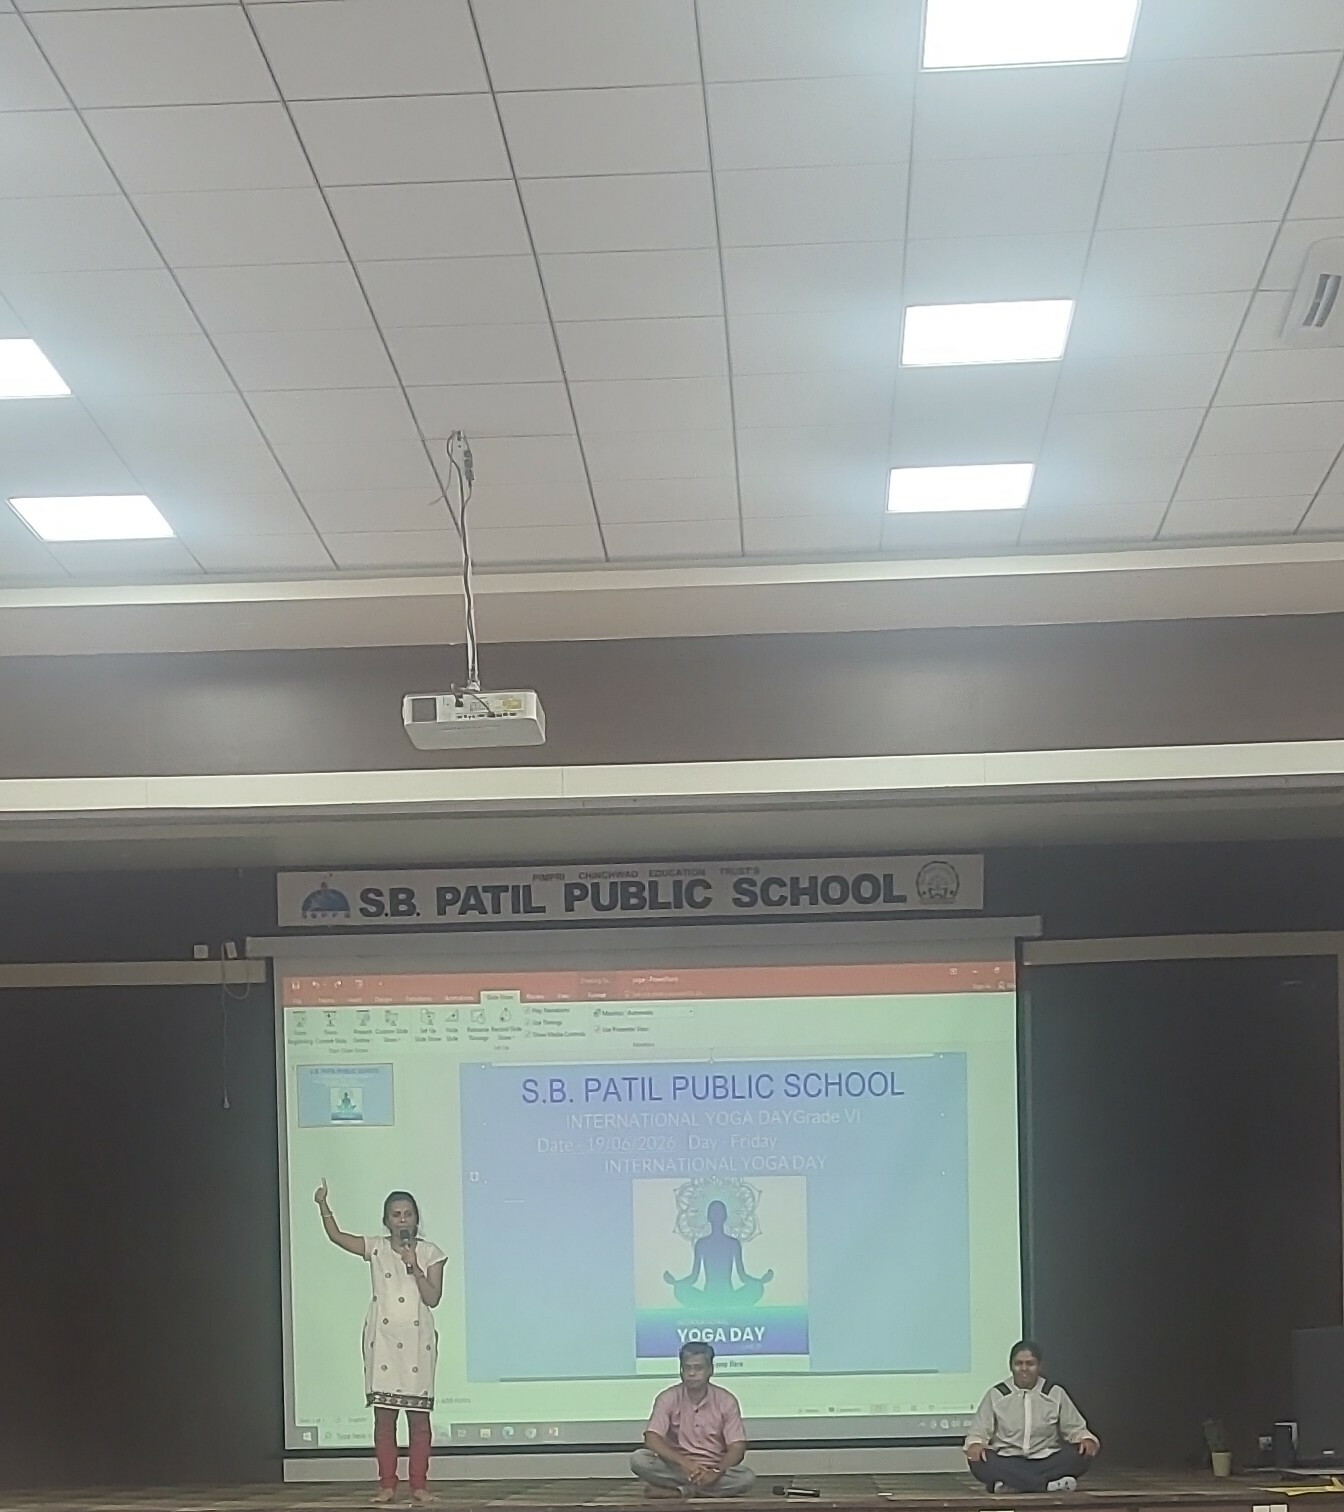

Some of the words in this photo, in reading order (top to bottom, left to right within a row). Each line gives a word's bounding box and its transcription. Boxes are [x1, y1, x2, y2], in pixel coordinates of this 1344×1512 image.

[578, 869, 639, 881] CHINCHWAD
[648, 867, 706, 878] EDUCATION
[359, 886, 422, 918] S.B.
[436, 884, 547, 917] PATIL
[564, 878, 713, 913] PUBLIC
[731, 873, 908, 909] SCHOOL
[522, 1079, 574, 1104] S.B.
[584, 1076, 662, 1103] PATIL
[672, 1073, 775, 1101] PUBLIC
[784, 1071, 906, 1098] SCHOOL
[566, 1112, 701, 1129] INTERNATIONAL
[705, 1110, 754, 1127] YOGA
[537, 1136, 574, 1154] Date
[586, 1134, 676, 1153] 19/06/2026
[688, 1134, 718, 1152] Day
[730, 1133, 778, 1152] Friday
[604, 1157, 737, 1174] INTERNATIONAL
[741, 1155, 787, 1172] YOGA
[792, 1154, 829, 1171] DAY
[677, 1328, 726, 1343] YOGA
[730, 1326, 766, 1342] DAY
